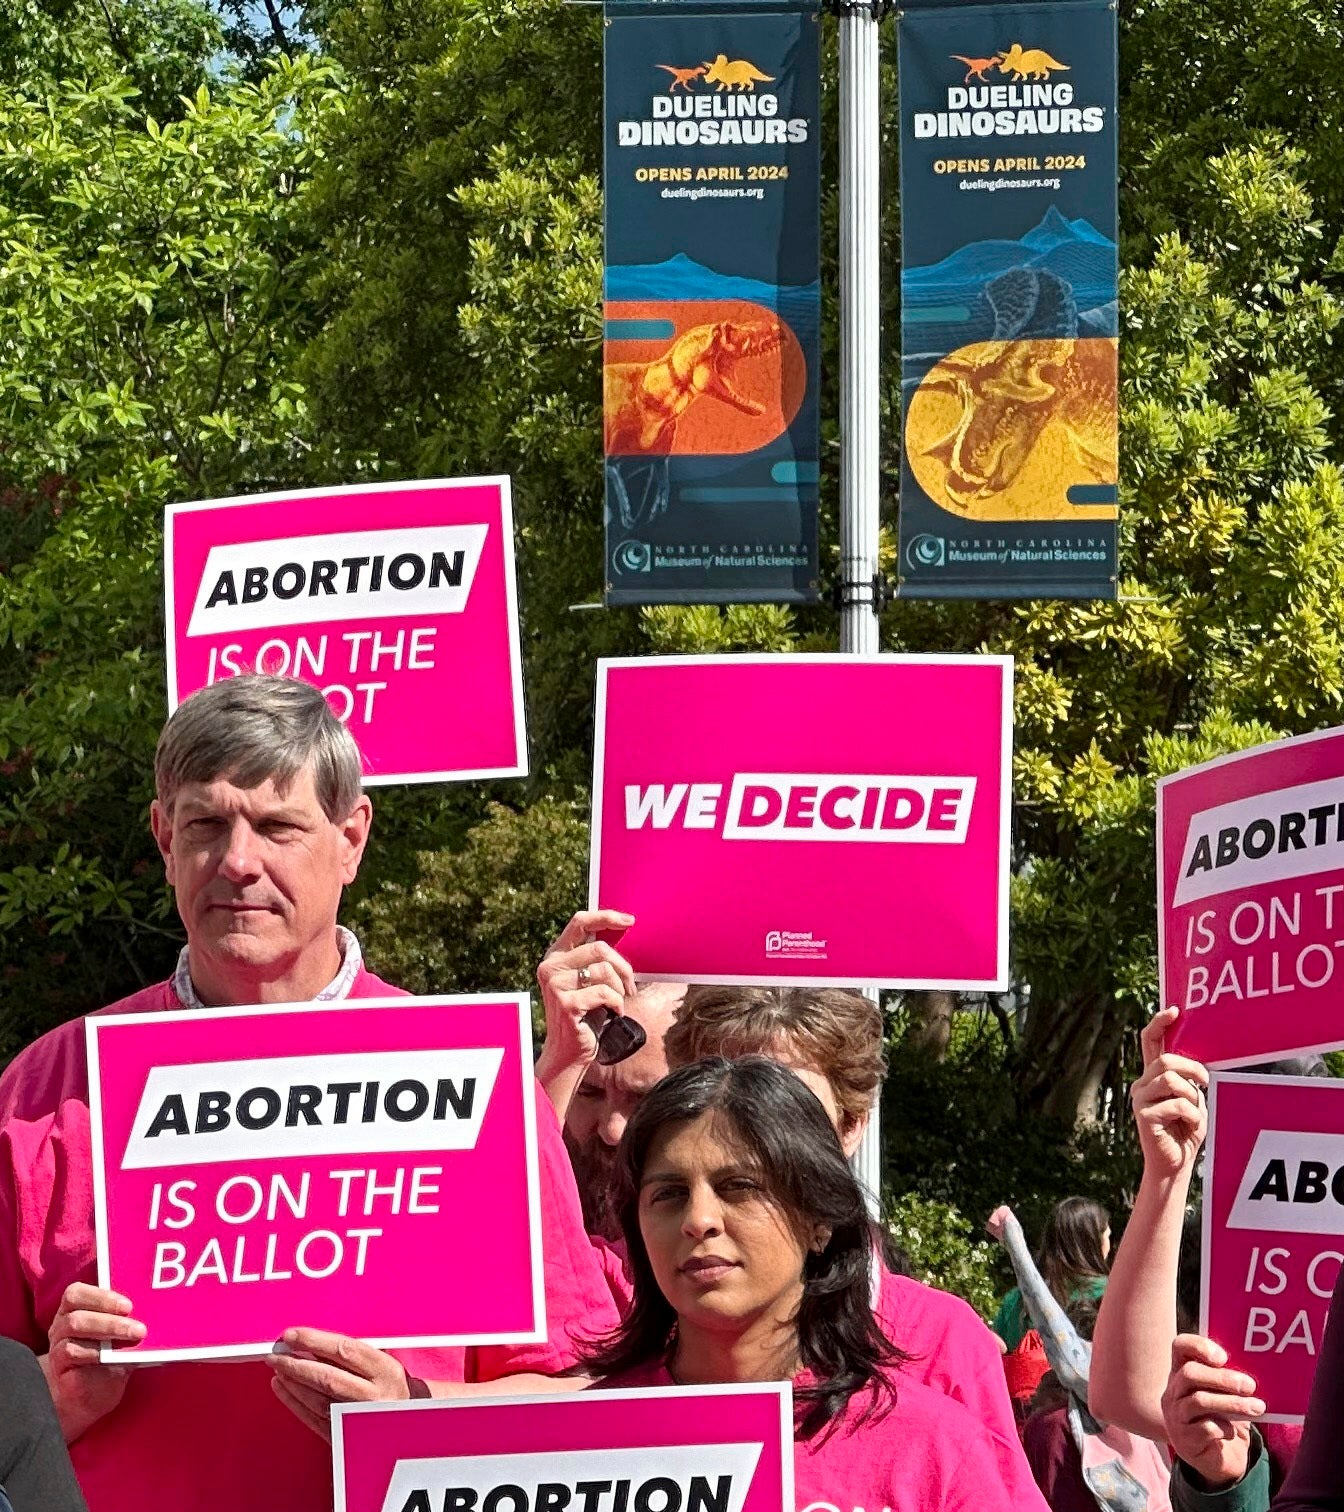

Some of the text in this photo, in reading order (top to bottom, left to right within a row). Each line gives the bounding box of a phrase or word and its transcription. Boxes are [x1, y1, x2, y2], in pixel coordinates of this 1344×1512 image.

[653, 94, 778, 118] DUELING
[948, 83, 1073, 109] DUELING
[619, 118, 808, 146] DINOSAURS
[914, 107, 1104, 138] DINOSAURS
[635, 166, 789, 182] OPENS APRIL 2024
[933, 155, 1086, 174] OPENS APRIL 2024
[661, 187, 764, 200] duelingdinosaurs.org
[960, 178, 1061, 191] duelingdinosaurs.org
[949, 539, 1106, 548] NORTH CAROLINA
[949, 549, 1106, 564] Museum of Natural Sciences
[656, 557, 702, 567] Museum
[715, 556, 756, 566] Natural
[757, 555, 808, 566] Sciences
[205, 551, 465, 609] ABORTION
[256, 635, 327, 678] ON
[343, 627, 437, 673] THE
[623, 784, 967, 832] WE DECIDE
[1186, 907, 1220, 958] IS
[1228, 888, 1309, 949] ON
[145, 1077, 476, 1138] ABORTION
[147, 1166, 443, 1231] IS ON THE
[152, 1228, 382, 1290] BALLOT
[1244, 1246, 1287, 1296] IS
